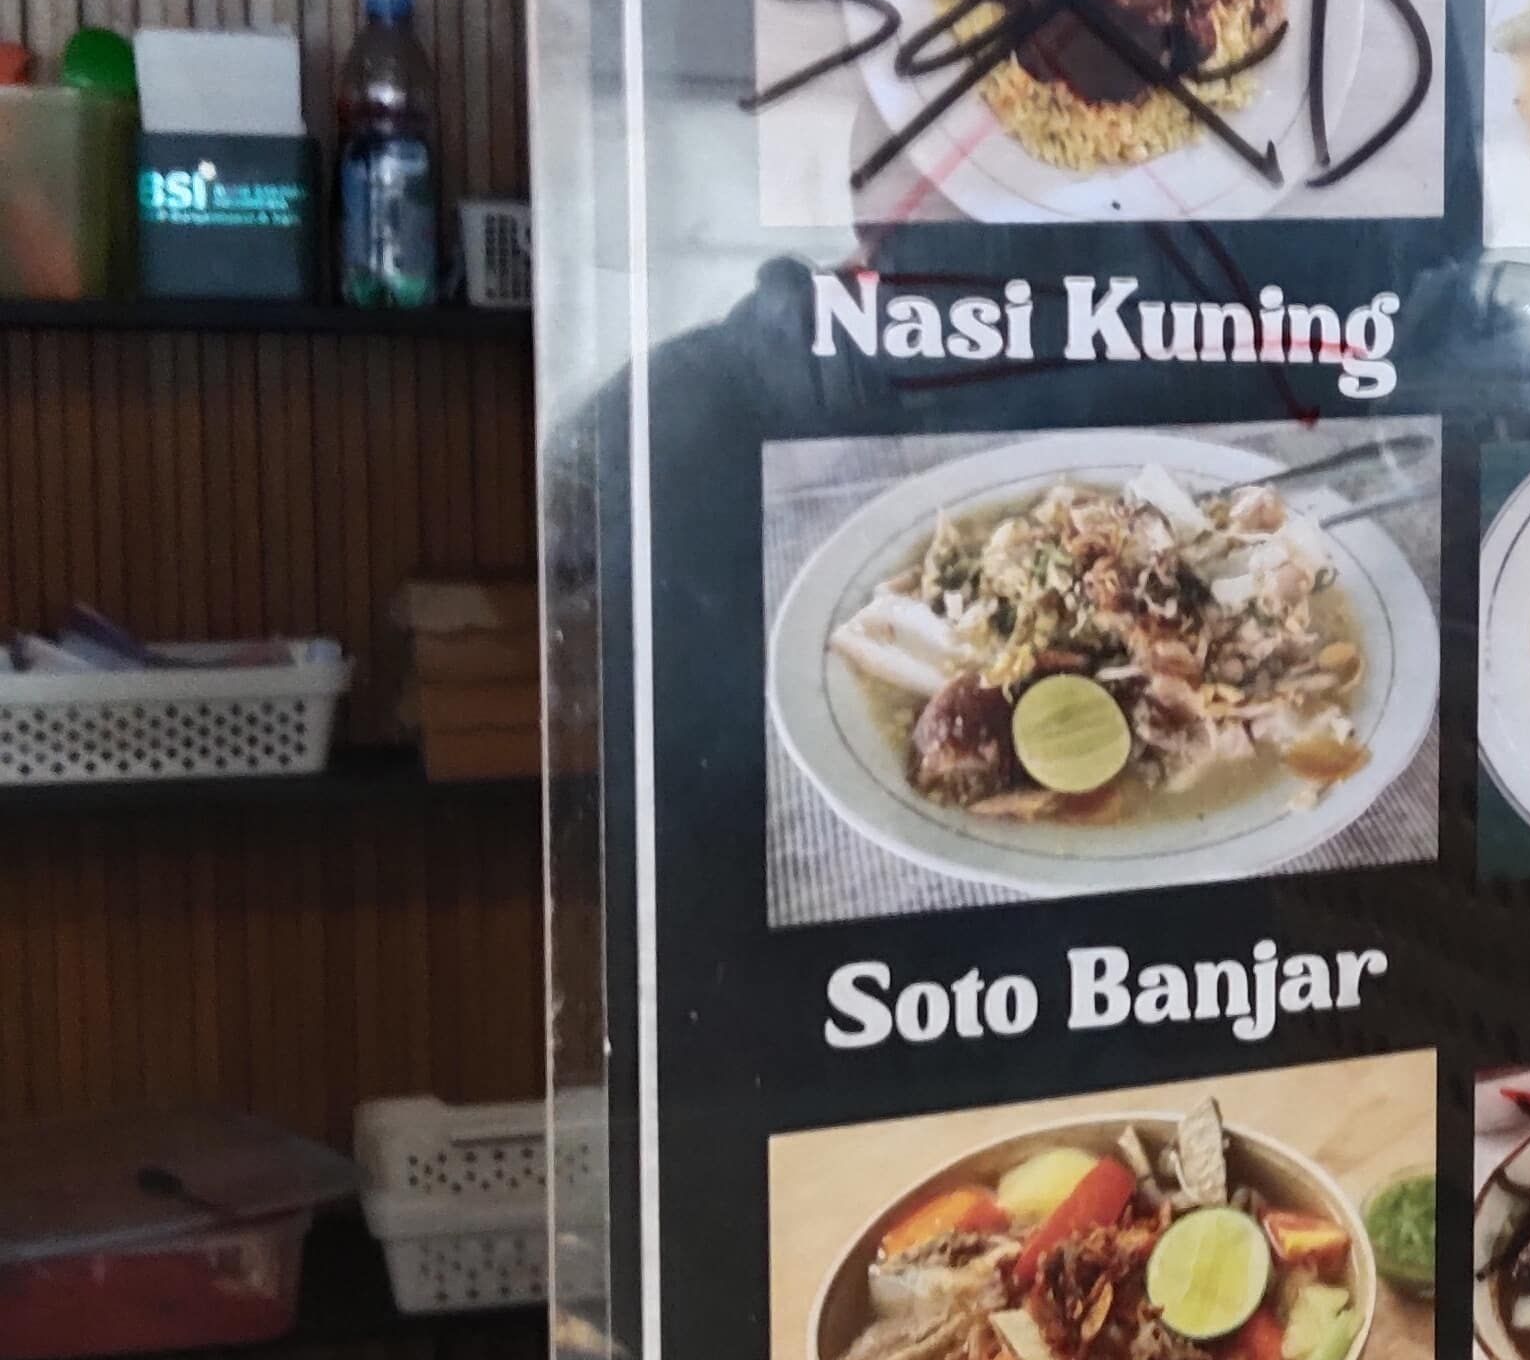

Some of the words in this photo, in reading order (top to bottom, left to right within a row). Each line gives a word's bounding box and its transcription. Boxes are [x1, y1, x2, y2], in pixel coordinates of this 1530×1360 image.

[811, 270, 1036, 362] Nasi
[1062, 275, 1400, 400] Kuning
[823, 958, 1040, 1047] Soto
[1066, 940, 1388, 1040] Banjar
